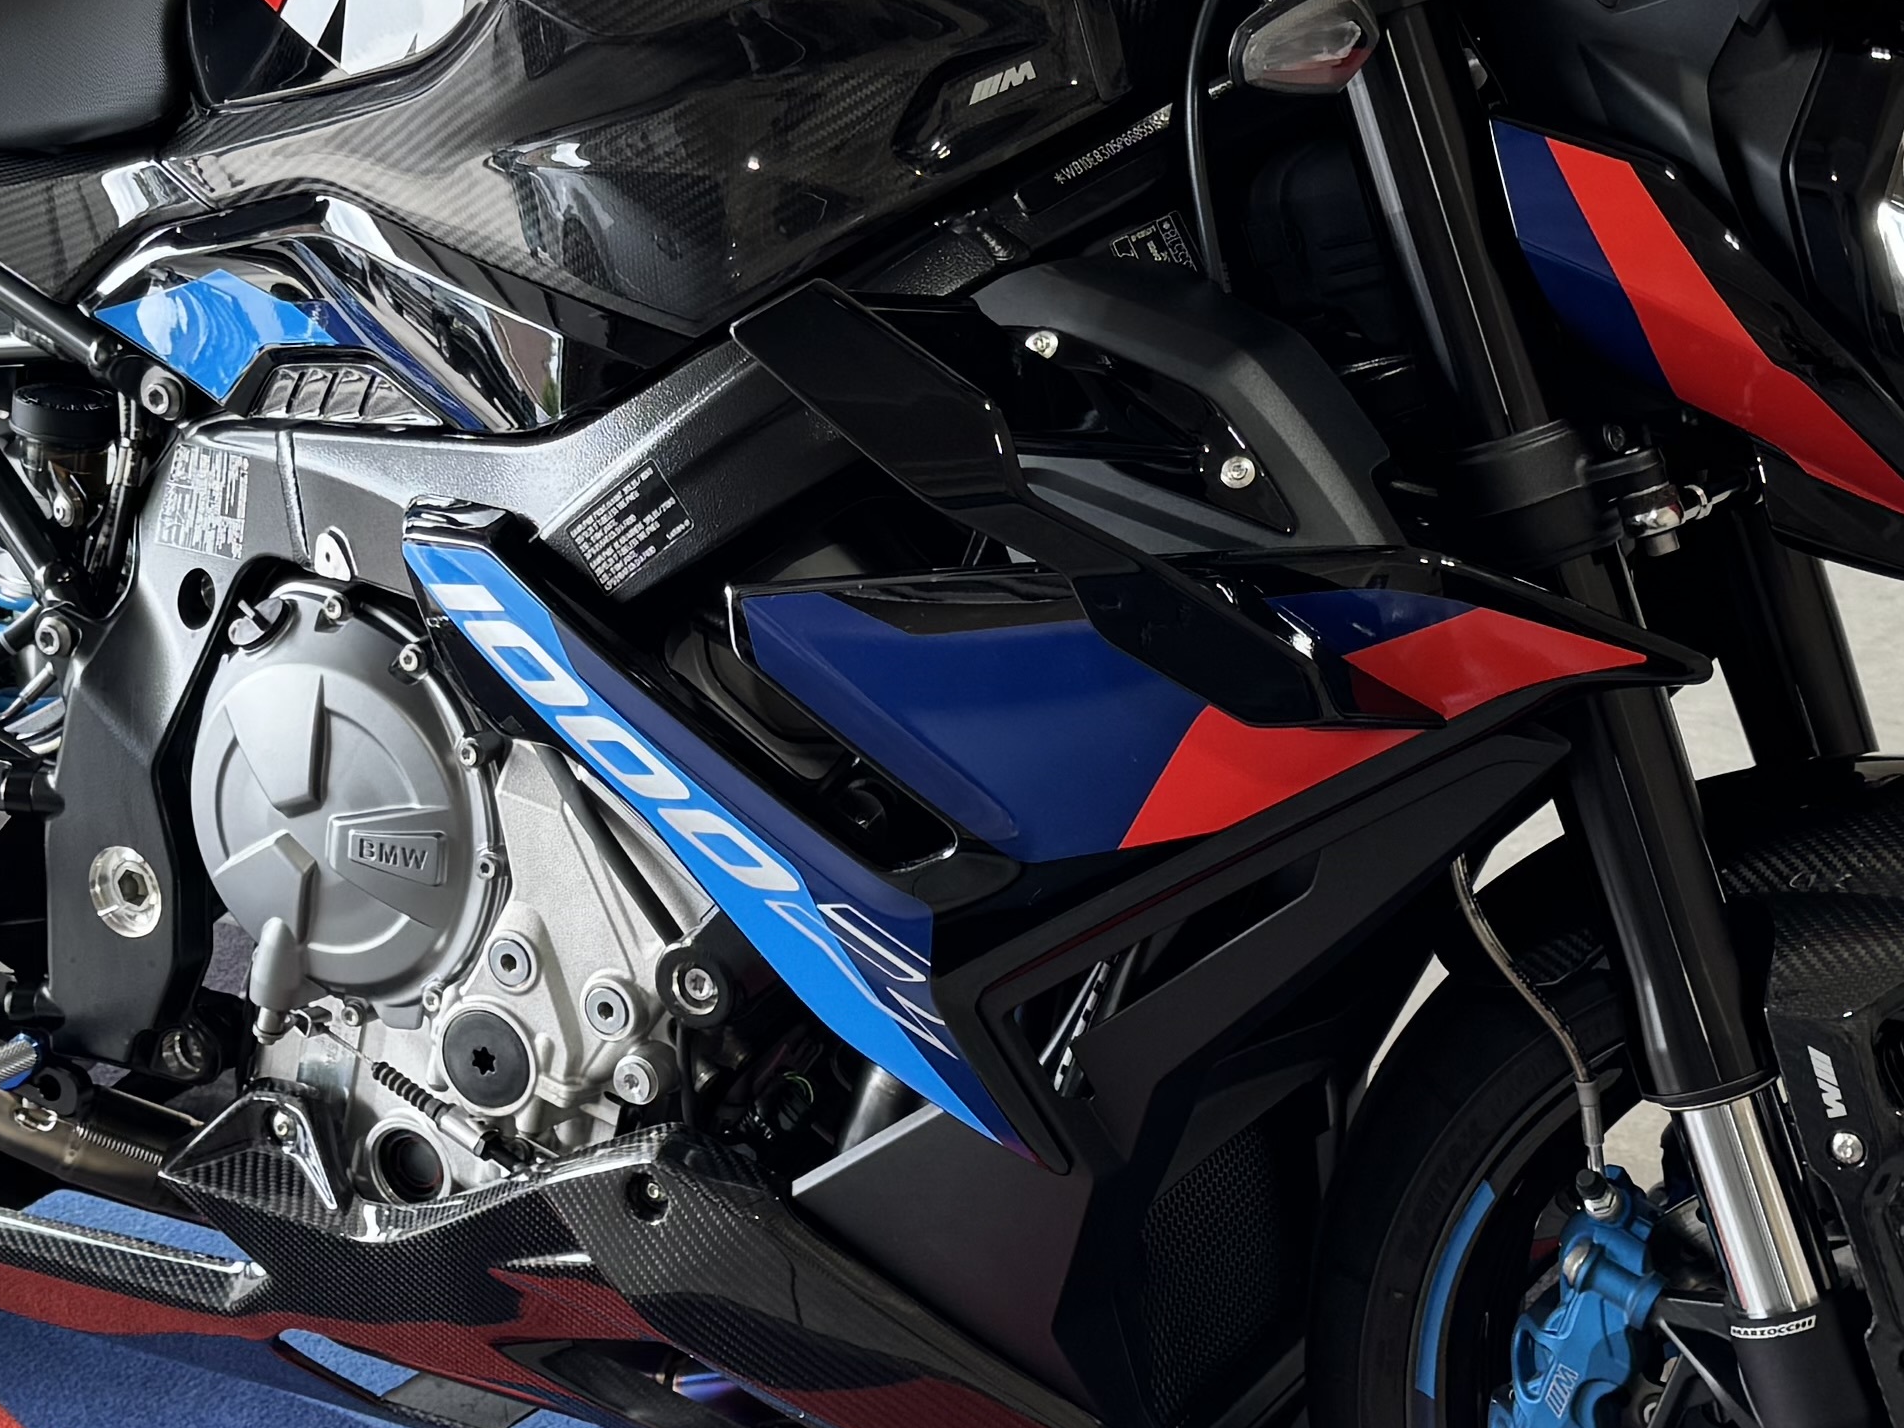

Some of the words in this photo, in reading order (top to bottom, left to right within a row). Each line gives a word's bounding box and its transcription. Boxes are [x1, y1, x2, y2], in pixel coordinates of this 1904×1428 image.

[427, 583, 800, 892] 1000
[357, 838, 429, 872] BMW
[1732, 1317, 1814, 1337] MARZOCCHI
